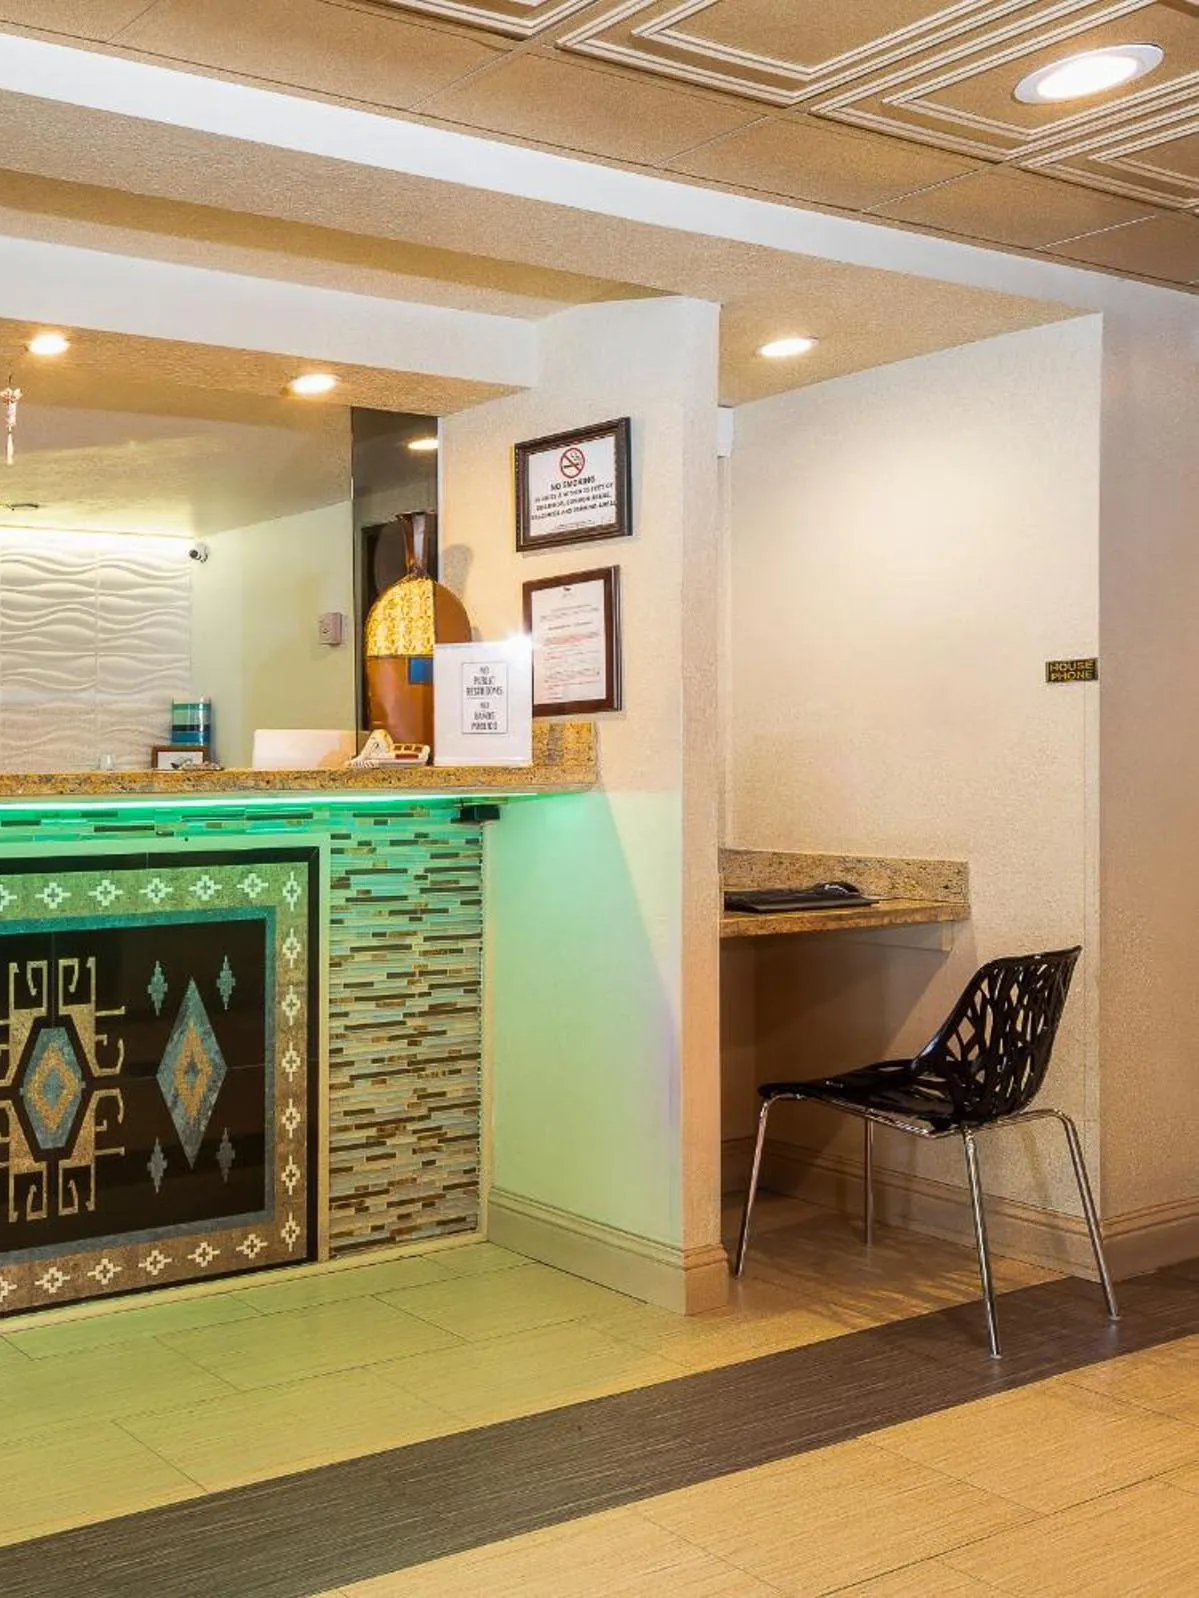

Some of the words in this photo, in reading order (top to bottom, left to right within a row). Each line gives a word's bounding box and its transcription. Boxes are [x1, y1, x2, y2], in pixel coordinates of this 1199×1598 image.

[550, 482, 561, 491] NO
[1050, 660, 1094, 671] HOUSE
[1051, 670, 1094, 680] PHONE
